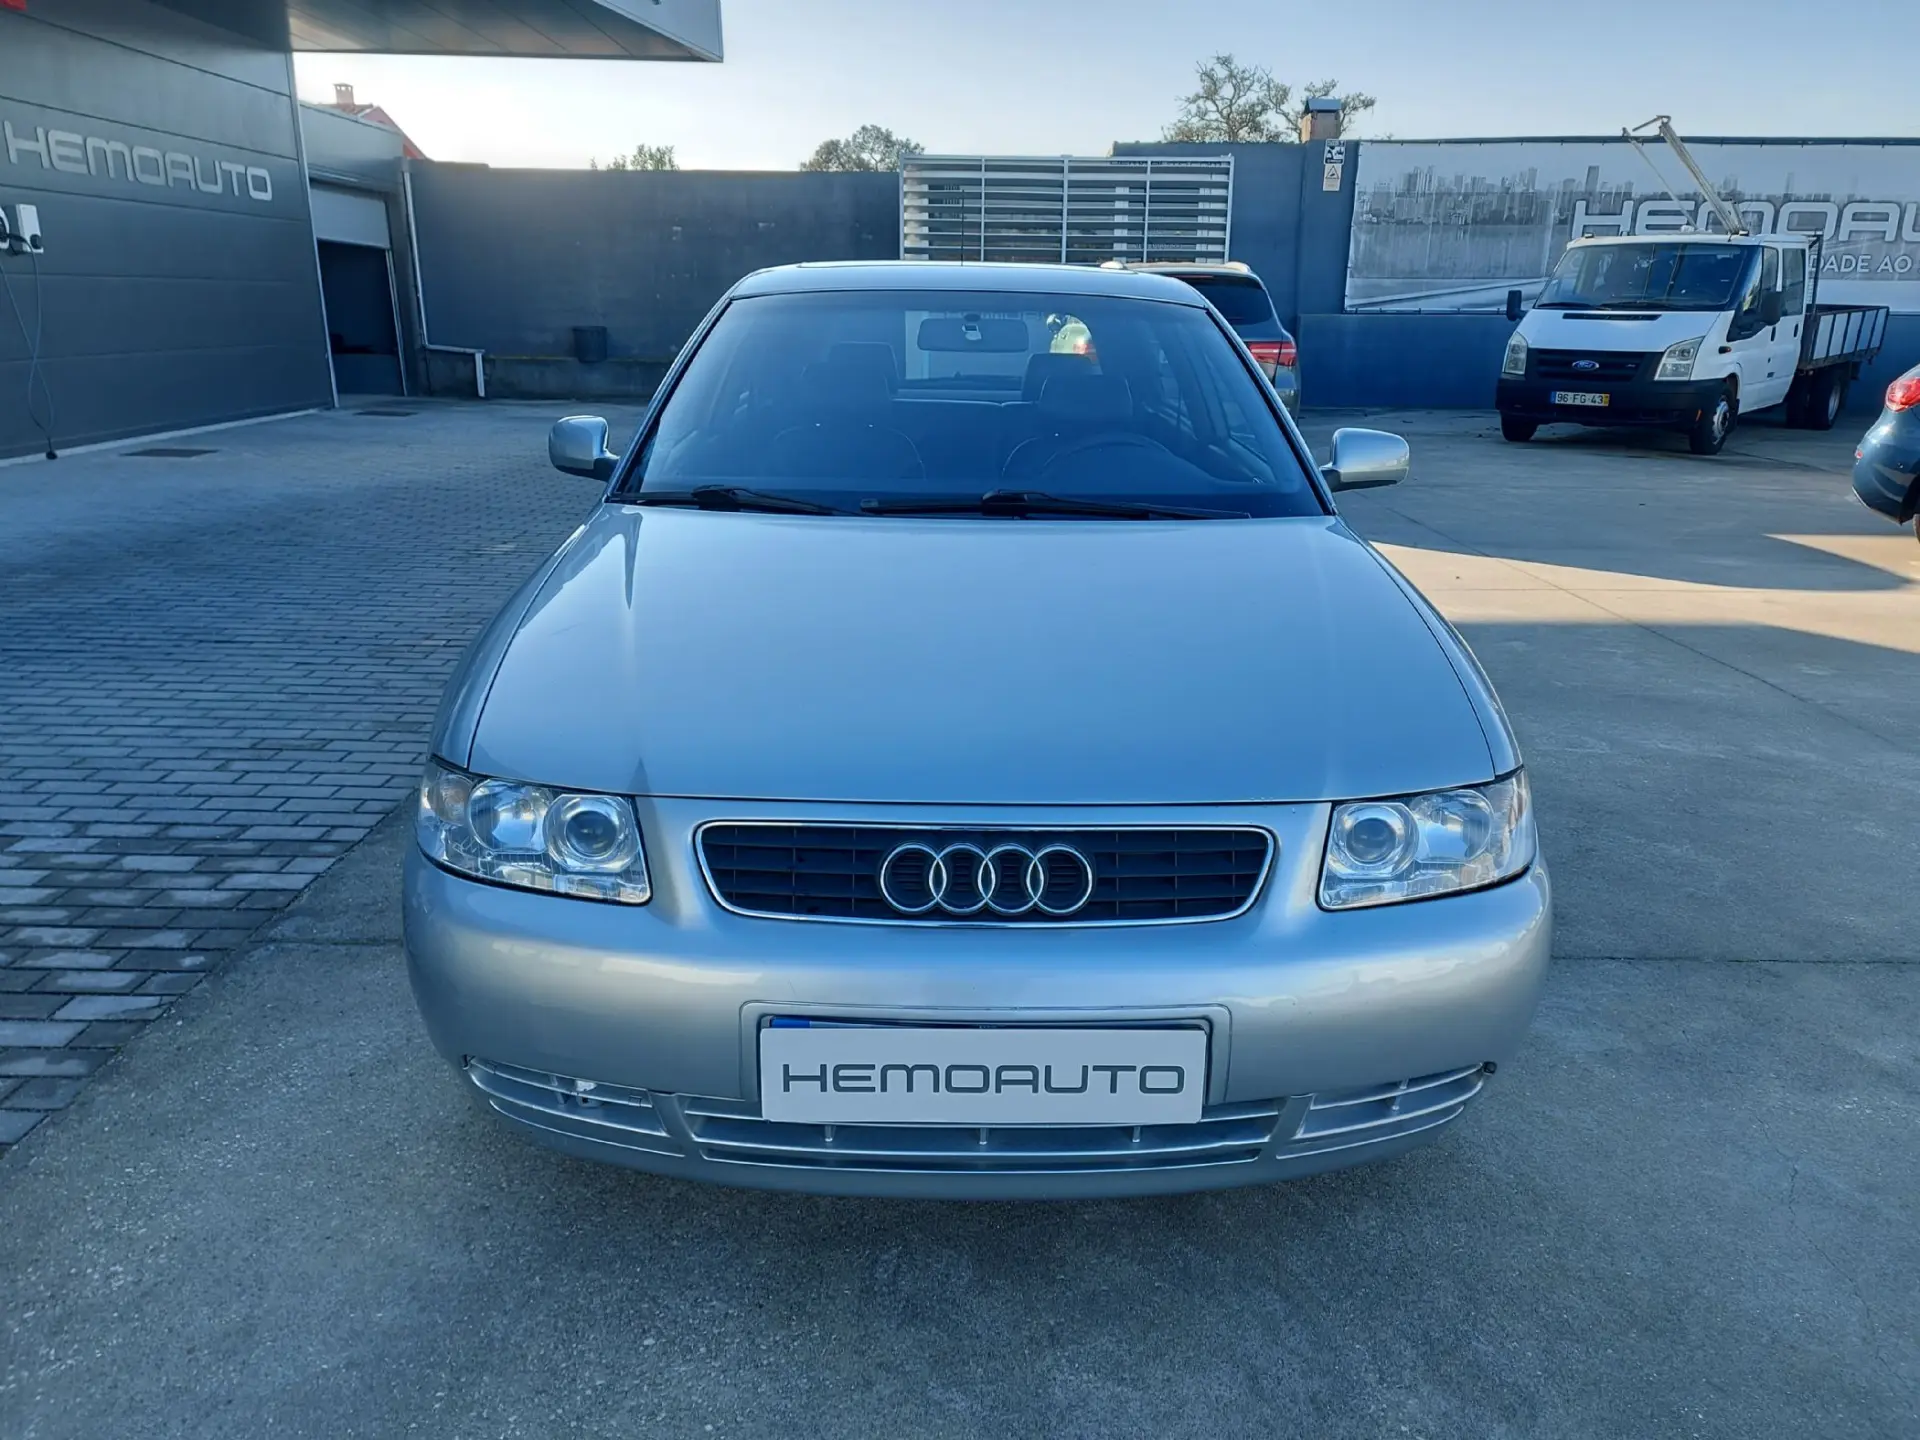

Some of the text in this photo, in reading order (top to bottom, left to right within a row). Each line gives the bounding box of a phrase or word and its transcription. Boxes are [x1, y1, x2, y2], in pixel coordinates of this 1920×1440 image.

[4, 120, 272, 201] HEMOAUTO
[1876, 254, 1912, 274] AO
[782, 1063, 1185, 1094] HEMOAUTO
